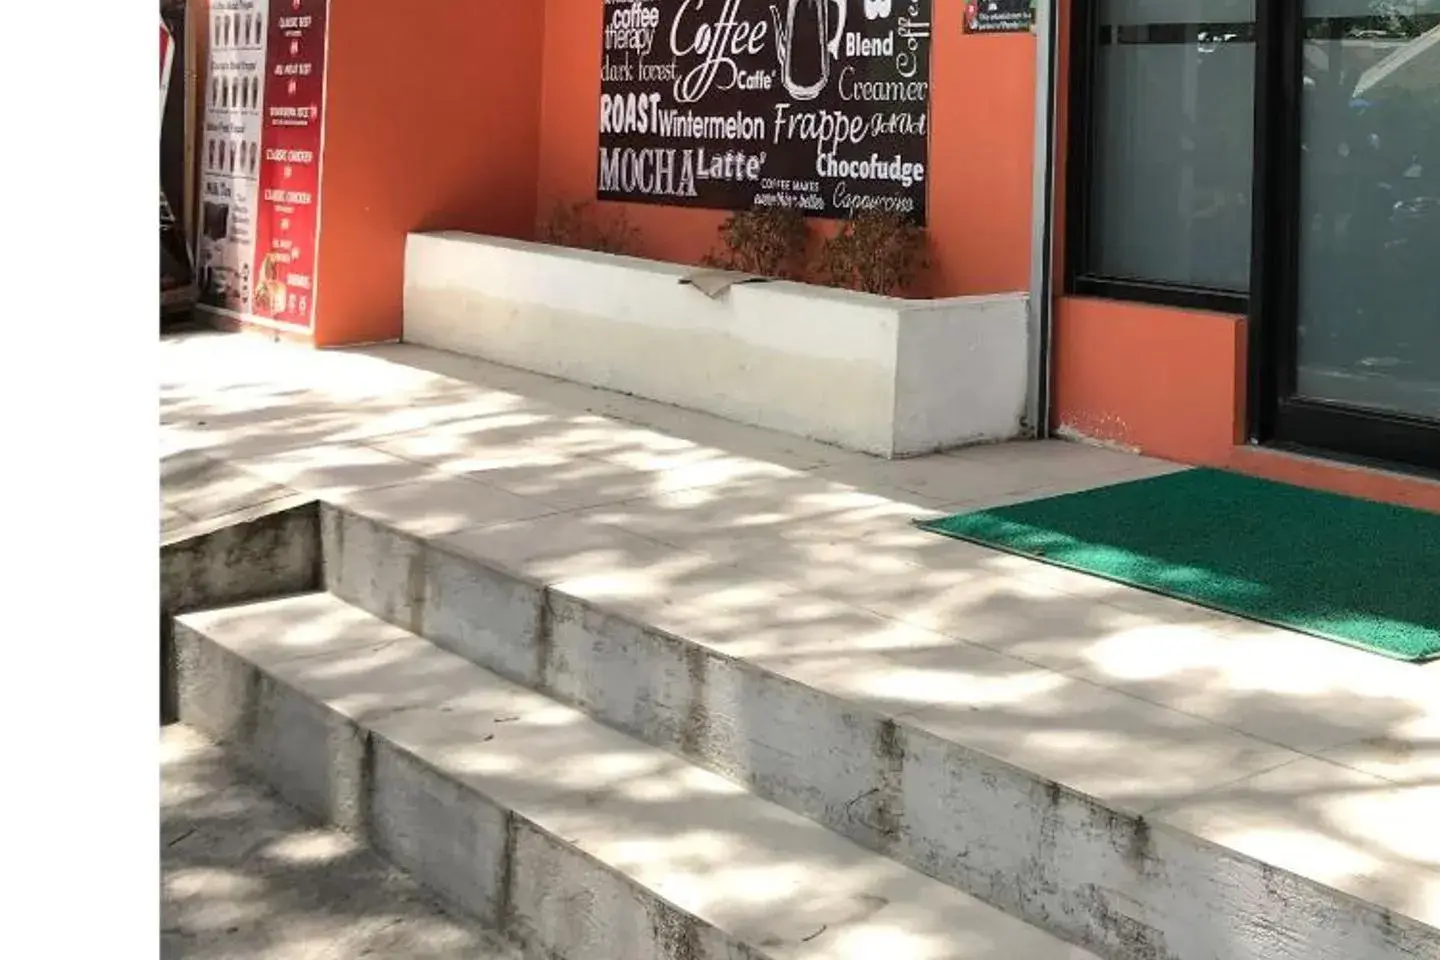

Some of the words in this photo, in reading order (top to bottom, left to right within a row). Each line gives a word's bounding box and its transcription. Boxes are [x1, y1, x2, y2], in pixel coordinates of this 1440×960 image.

[612, 1, 660, 29] coffee
[605, 24, 656, 55] therapy
[846, 30, 893, 57] Blend
[601, 50, 634, 81] dark
[638, 54, 679, 81] forest
[839, 65, 928, 101] Creamer
[600, 92, 661, 134] ROAST
[659, 109, 765, 140] Wintermelon
[773, 103, 869, 157] Frappe
[599, 147, 698, 196] MOCHA
[816, 153, 924, 188] Chocofudge
